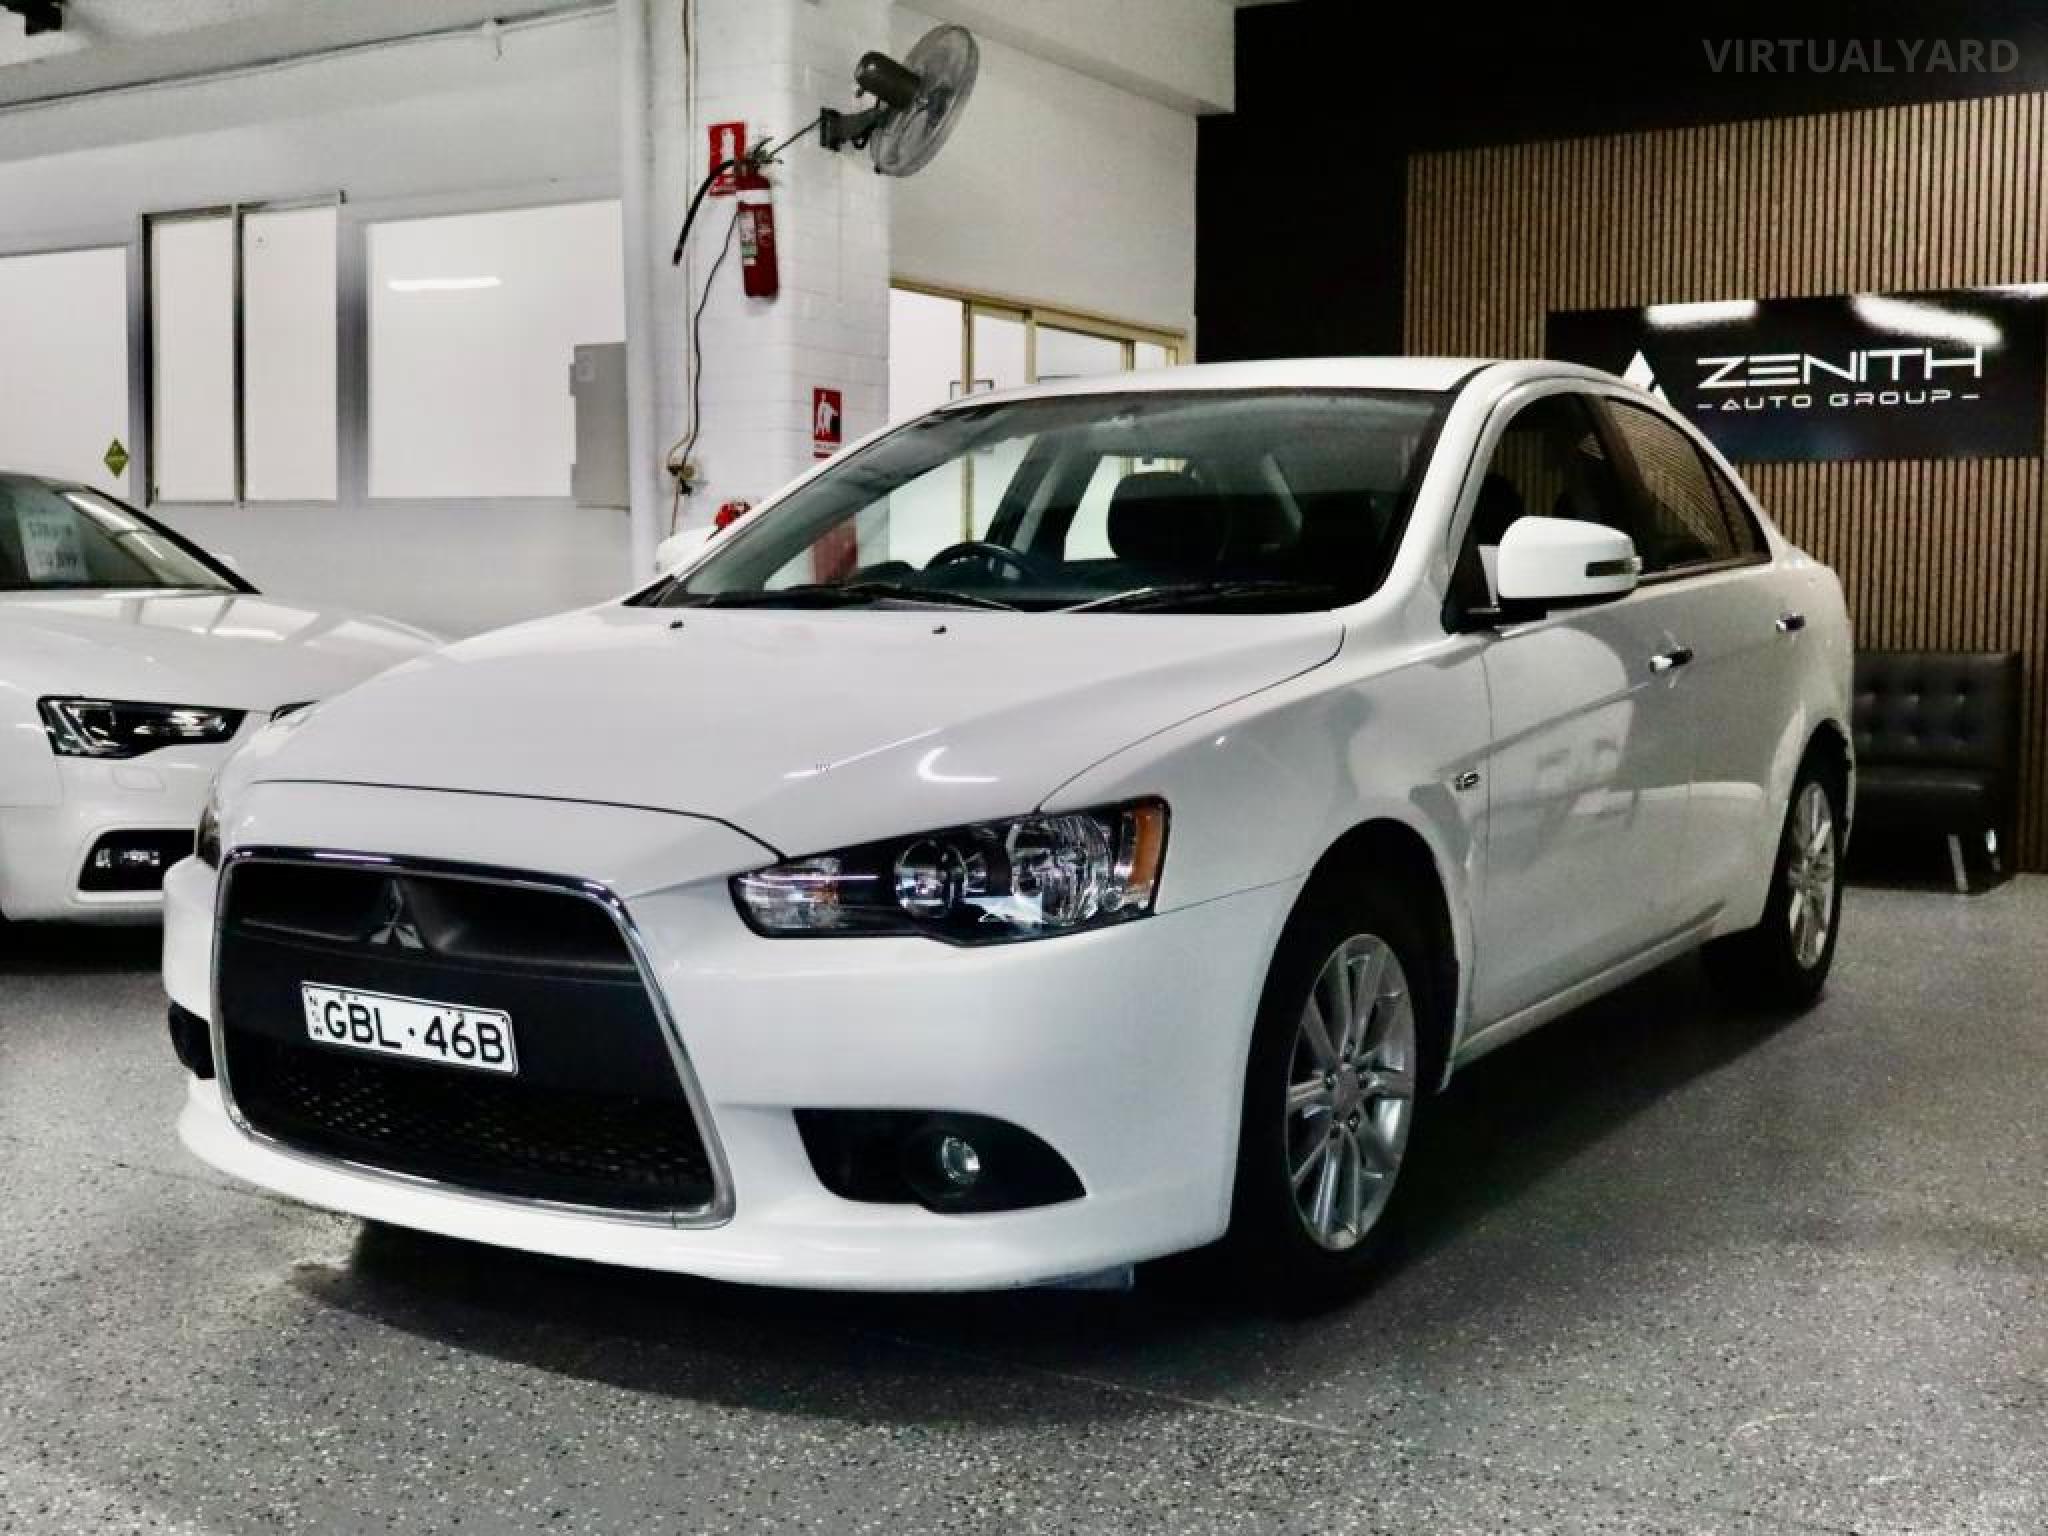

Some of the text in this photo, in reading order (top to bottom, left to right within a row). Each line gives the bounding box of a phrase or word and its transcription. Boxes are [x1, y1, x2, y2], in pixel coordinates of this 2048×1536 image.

[1697, 345, 1983, 389] ZENITH
[1721, 389, 1951, 411] AUTO GROUP
